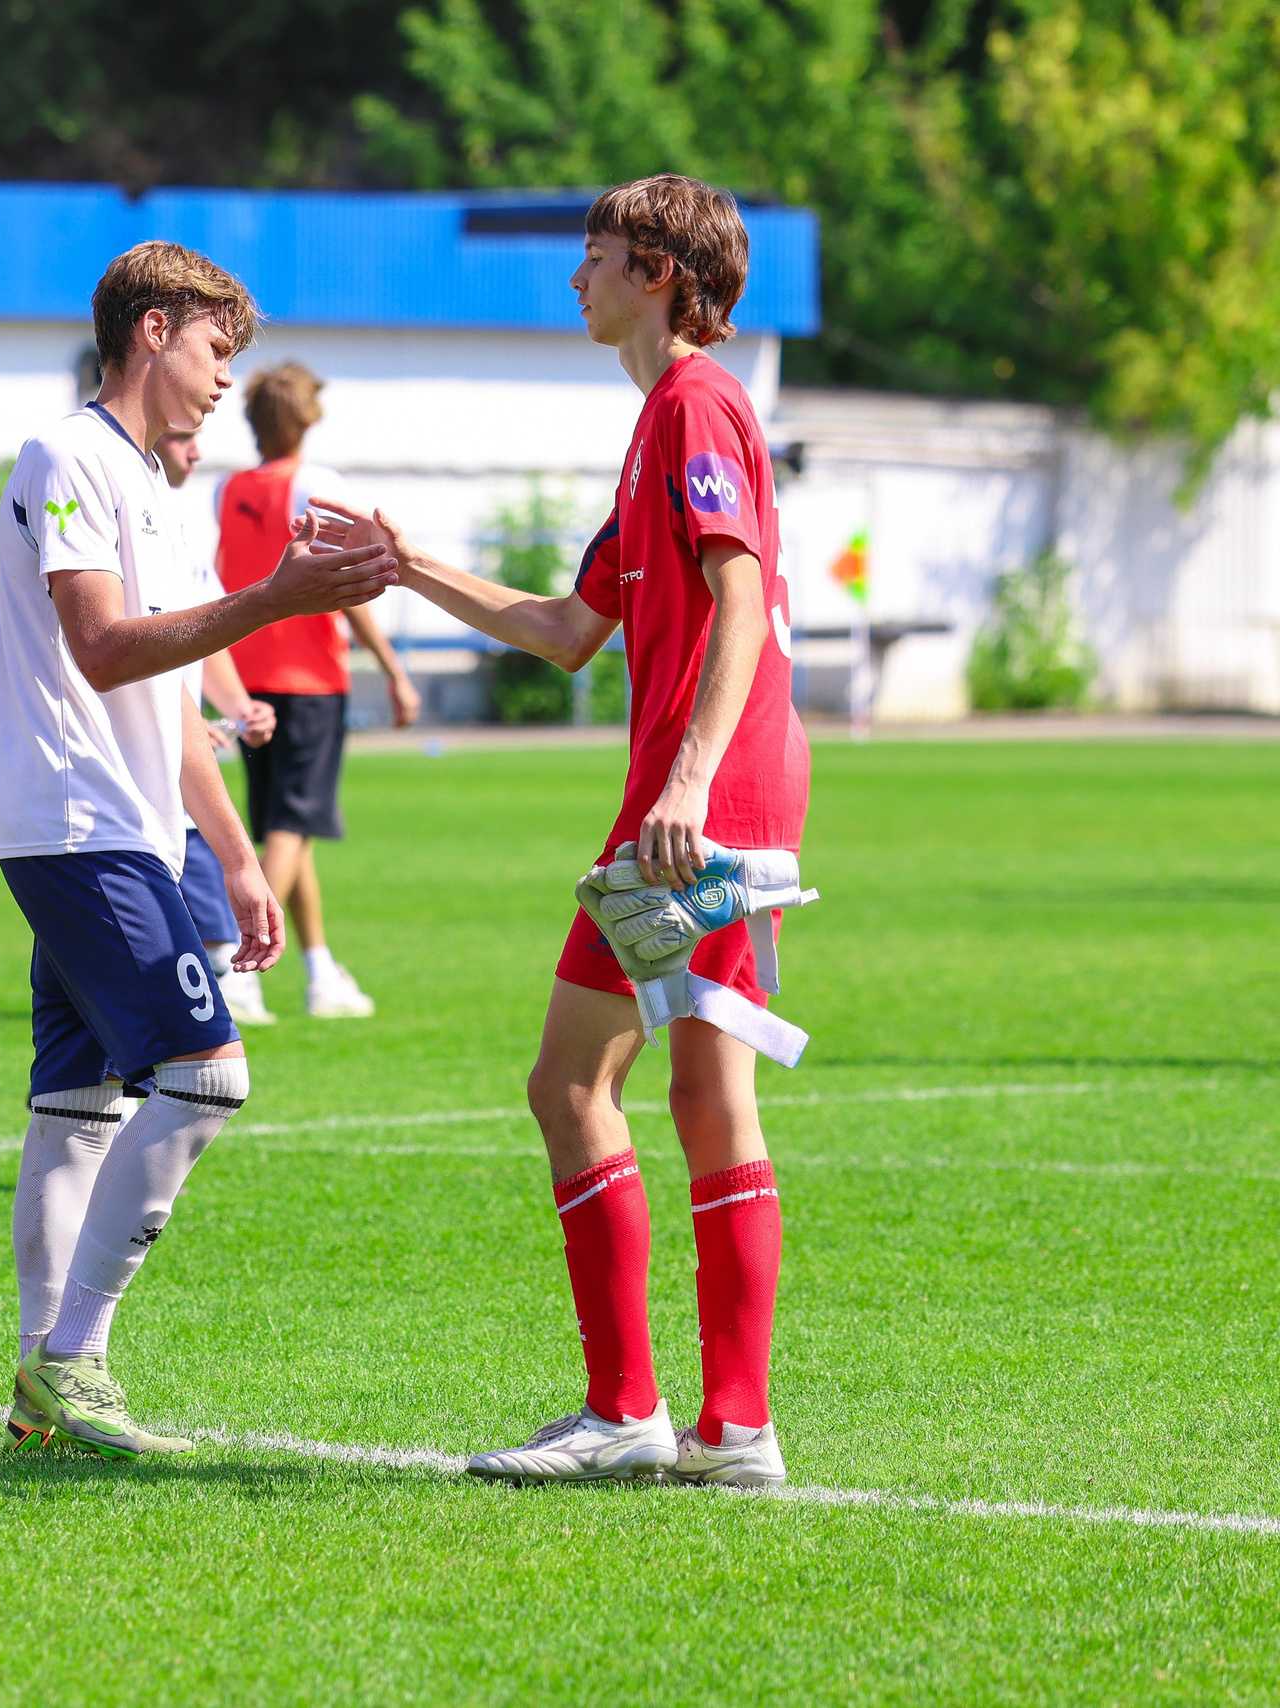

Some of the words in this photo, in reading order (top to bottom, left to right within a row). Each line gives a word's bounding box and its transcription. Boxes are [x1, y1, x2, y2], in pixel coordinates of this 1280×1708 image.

[177, 952, 215, 1022] 9
[609, 1164, 639, 1182] KEL
[129, 1236, 153, 1247] KEL
